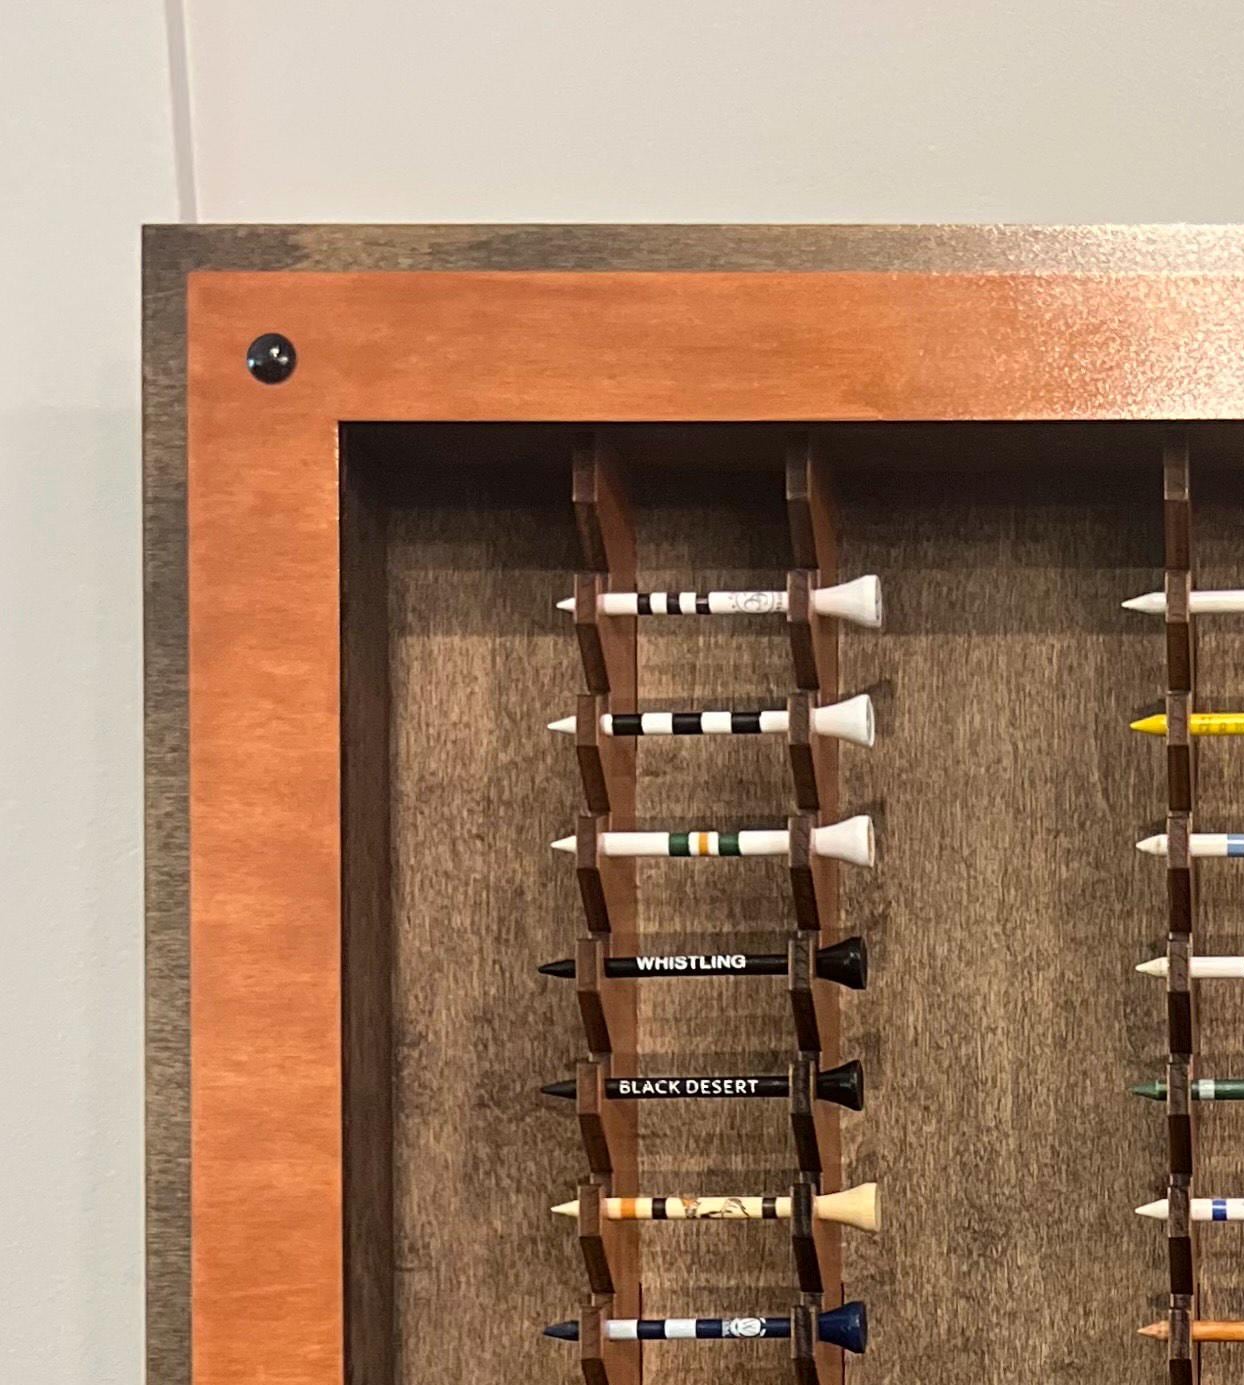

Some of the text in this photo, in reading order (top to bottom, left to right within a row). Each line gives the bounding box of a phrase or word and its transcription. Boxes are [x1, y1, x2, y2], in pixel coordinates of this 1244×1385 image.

[636, 954, 747, 971] WHISTLING
[619, 1079, 760, 1095] BLACK DESERT
